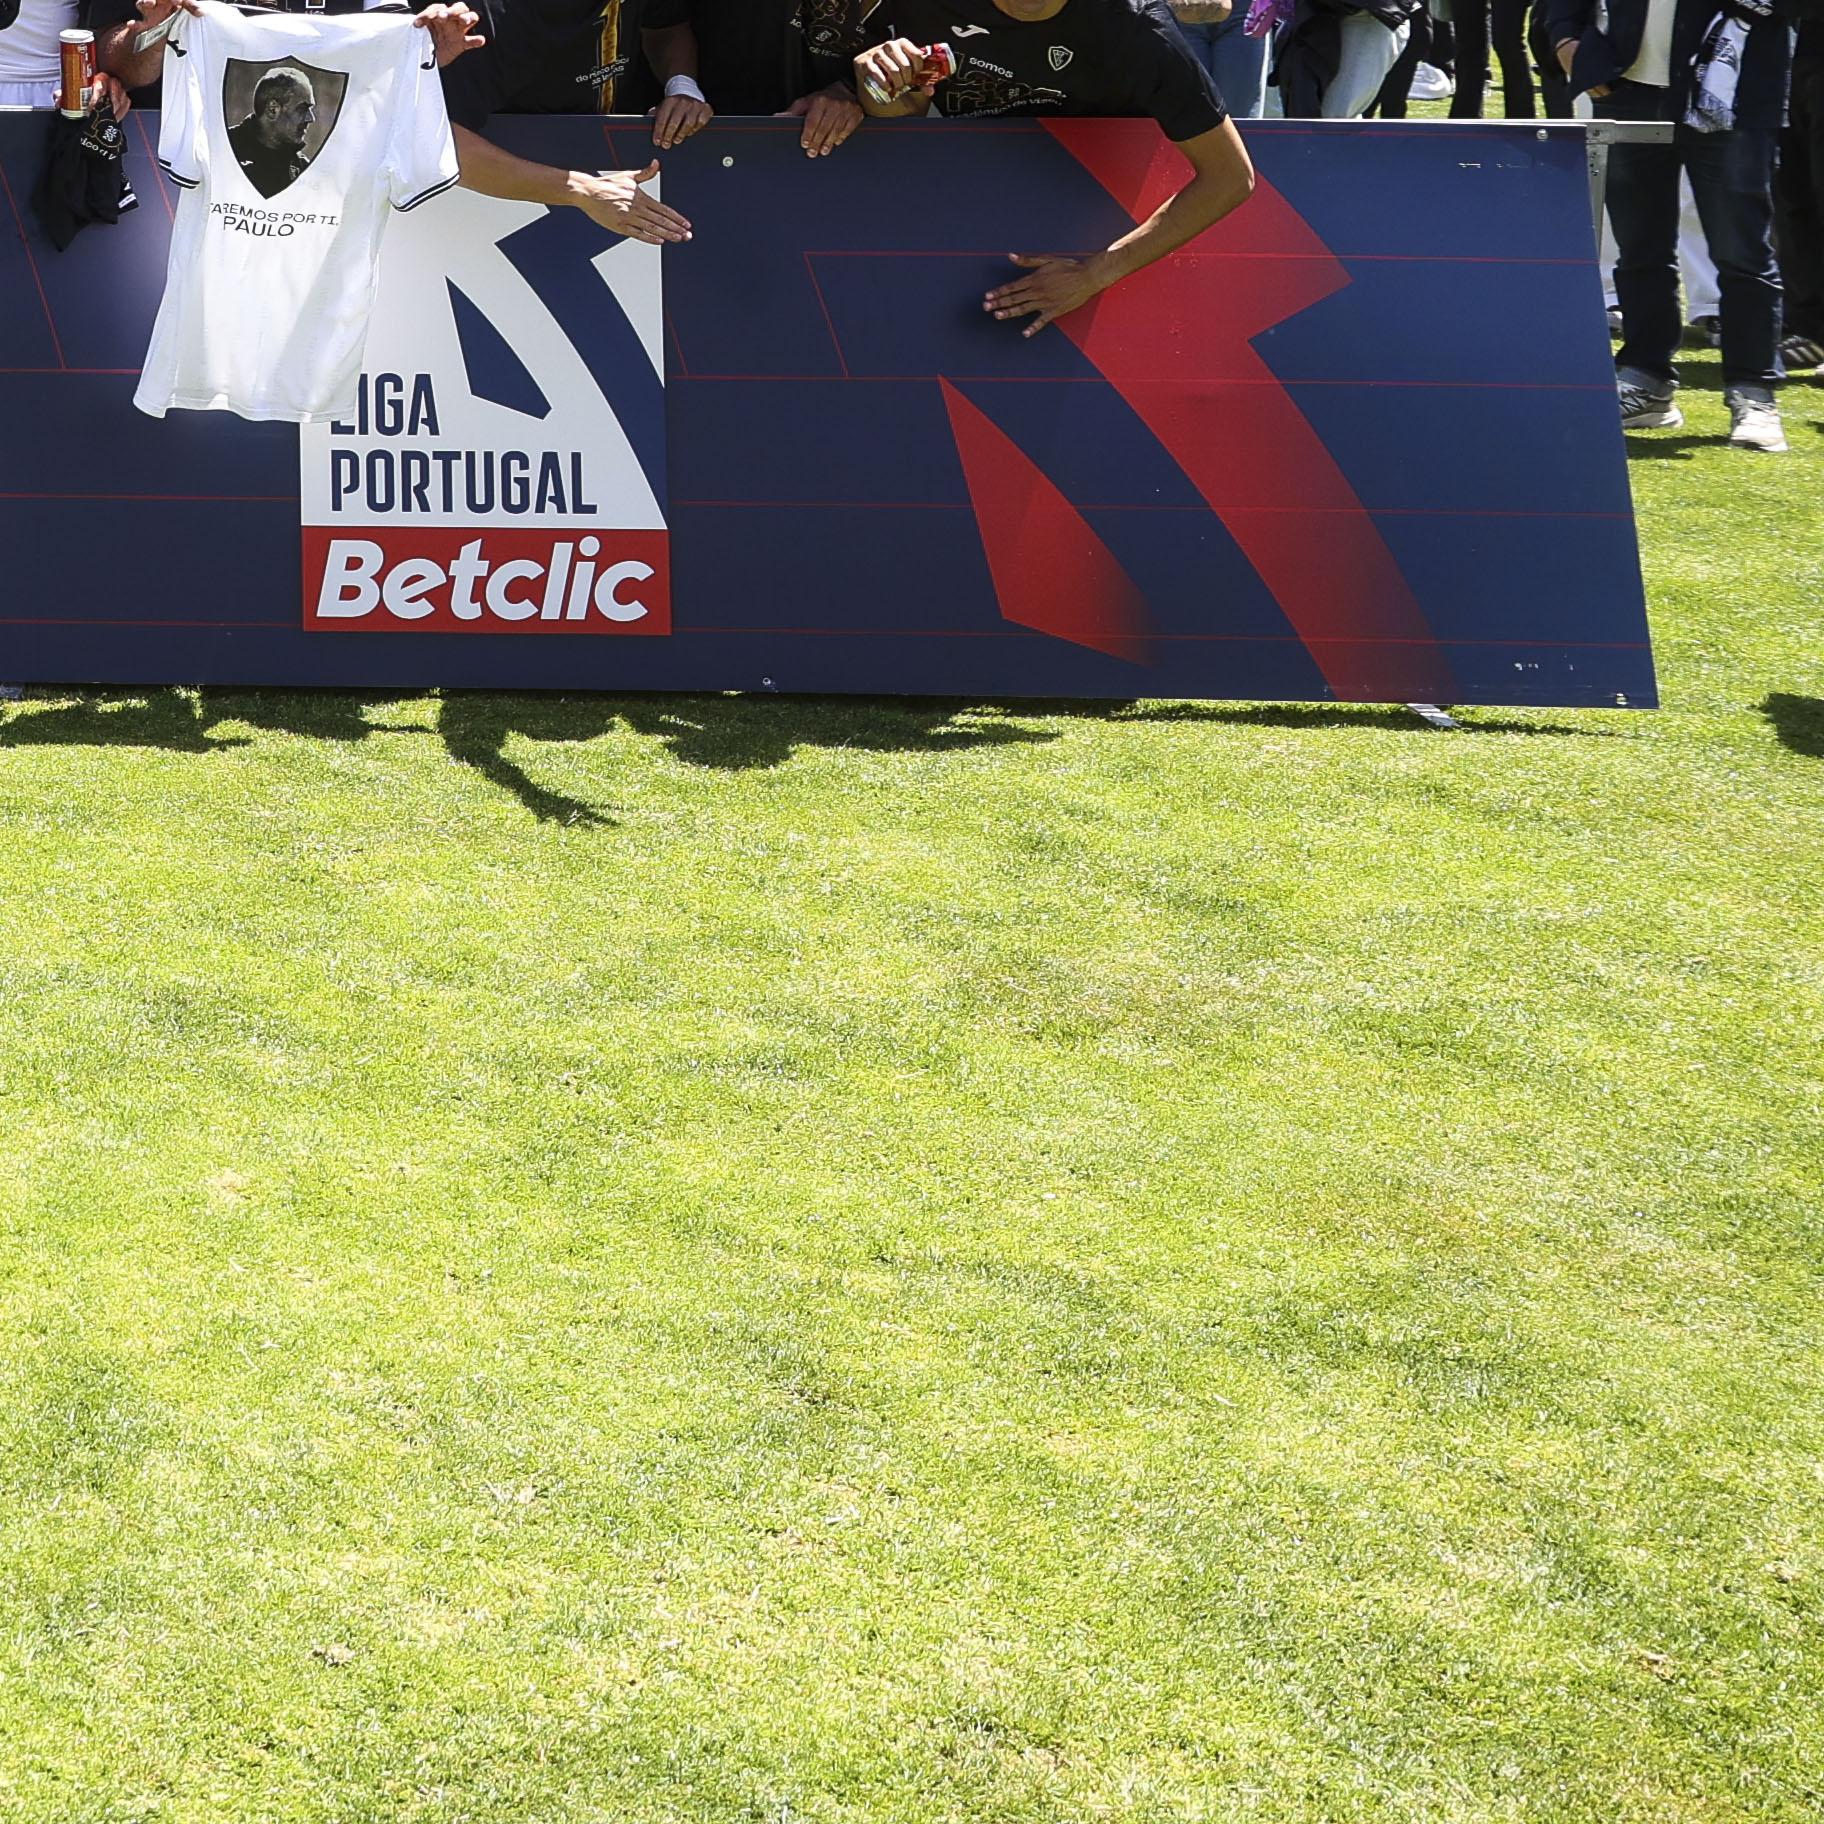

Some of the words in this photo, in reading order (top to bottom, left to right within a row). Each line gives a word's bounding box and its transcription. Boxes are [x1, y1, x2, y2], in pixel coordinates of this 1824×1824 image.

[969, 57, 1014, 78] somos
[222, 216, 295, 238] PAULO
[282, 212, 317, 225] POR
[330, 449, 598, 515] PORTUGAL
[316, 536, 655, 622] Betclic
